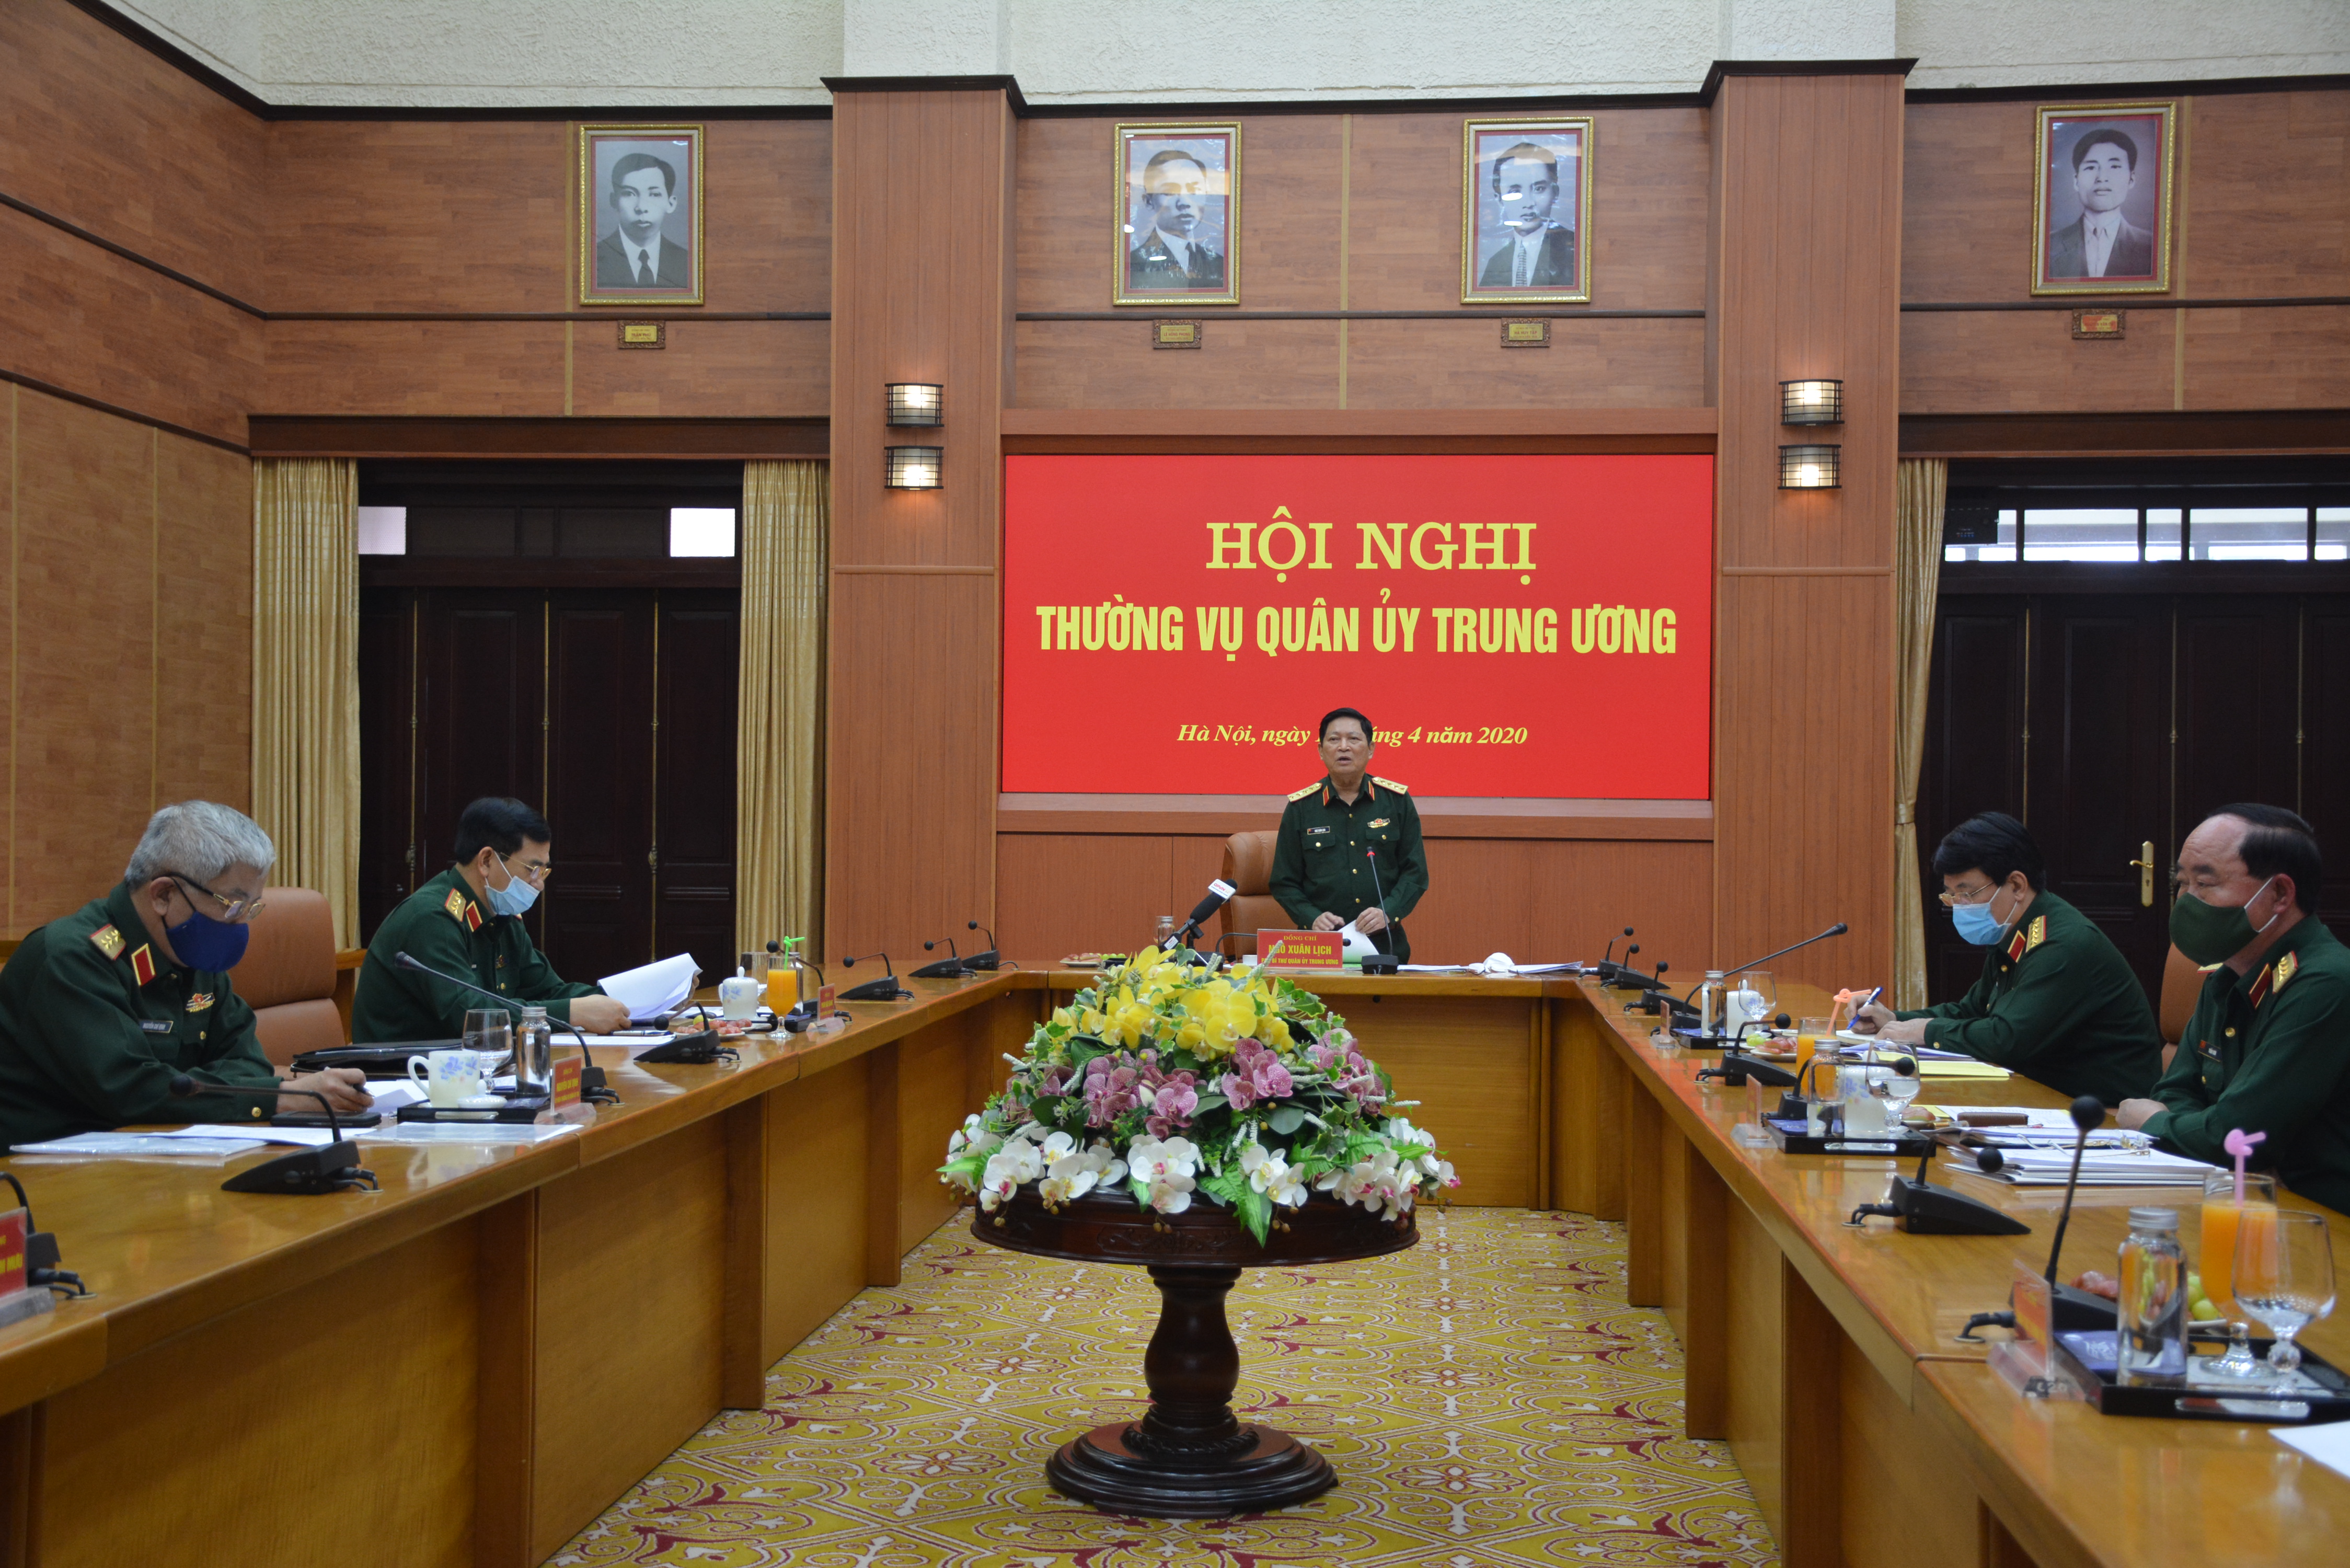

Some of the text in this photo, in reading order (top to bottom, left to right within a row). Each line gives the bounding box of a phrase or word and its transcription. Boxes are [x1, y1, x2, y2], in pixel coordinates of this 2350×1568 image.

[1206, 505, 1537, 585] HỘI NGHỊ
[1036, 587, 1676, 662] THƯỜNG VỤ QUÂN ỦY TRUNG ƯƠNG
[1177, 724, 1210, 742] Hà
[1213, 725, 1256, 746] Nội,
[1261, 726, 1311, 746] ngày
[1372, 726, 1404, 747] áng
[1407, 727, 1422, 743] 4
[1426, 727, 1473, 744] năm
[1476, 727, 1528, 744] 2020
[1288, 944, 1311, 954] XUÂN
[1313, 946, 1332, 956] LỊCH
